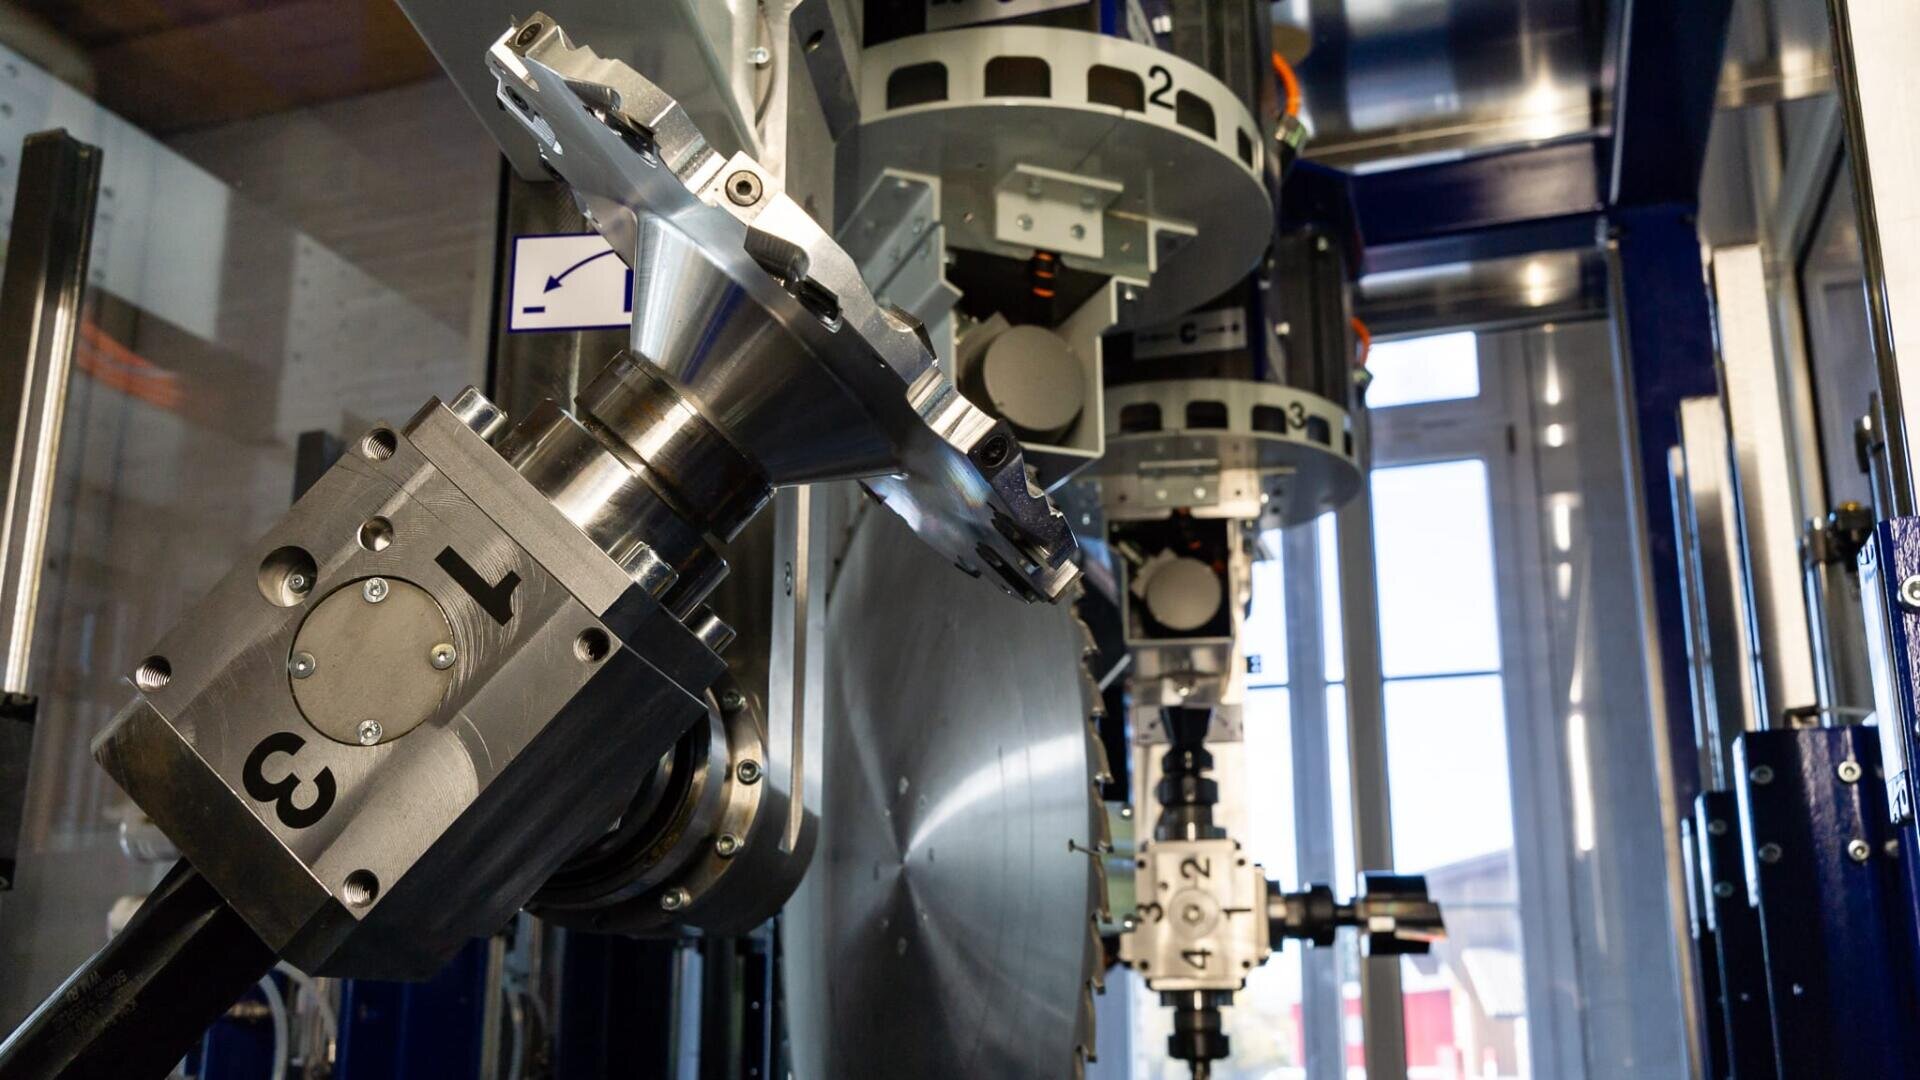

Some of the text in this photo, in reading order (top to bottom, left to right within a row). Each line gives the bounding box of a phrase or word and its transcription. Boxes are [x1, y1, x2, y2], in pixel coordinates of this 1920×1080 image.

[1147, 65, 1174, 109] 2
[1180, 322, 1197, 344] C
[1287, 402, 1307, 430] 3
[434, 545, 522, 627] 1
[241, 731, 337, 830] 3
[1179, 856, 1211, 879] 2
[1135, 902, 1164, 924] 3
[1222, 908, 1252, 920] 1
[1180, 949, 1212, 970] 4
